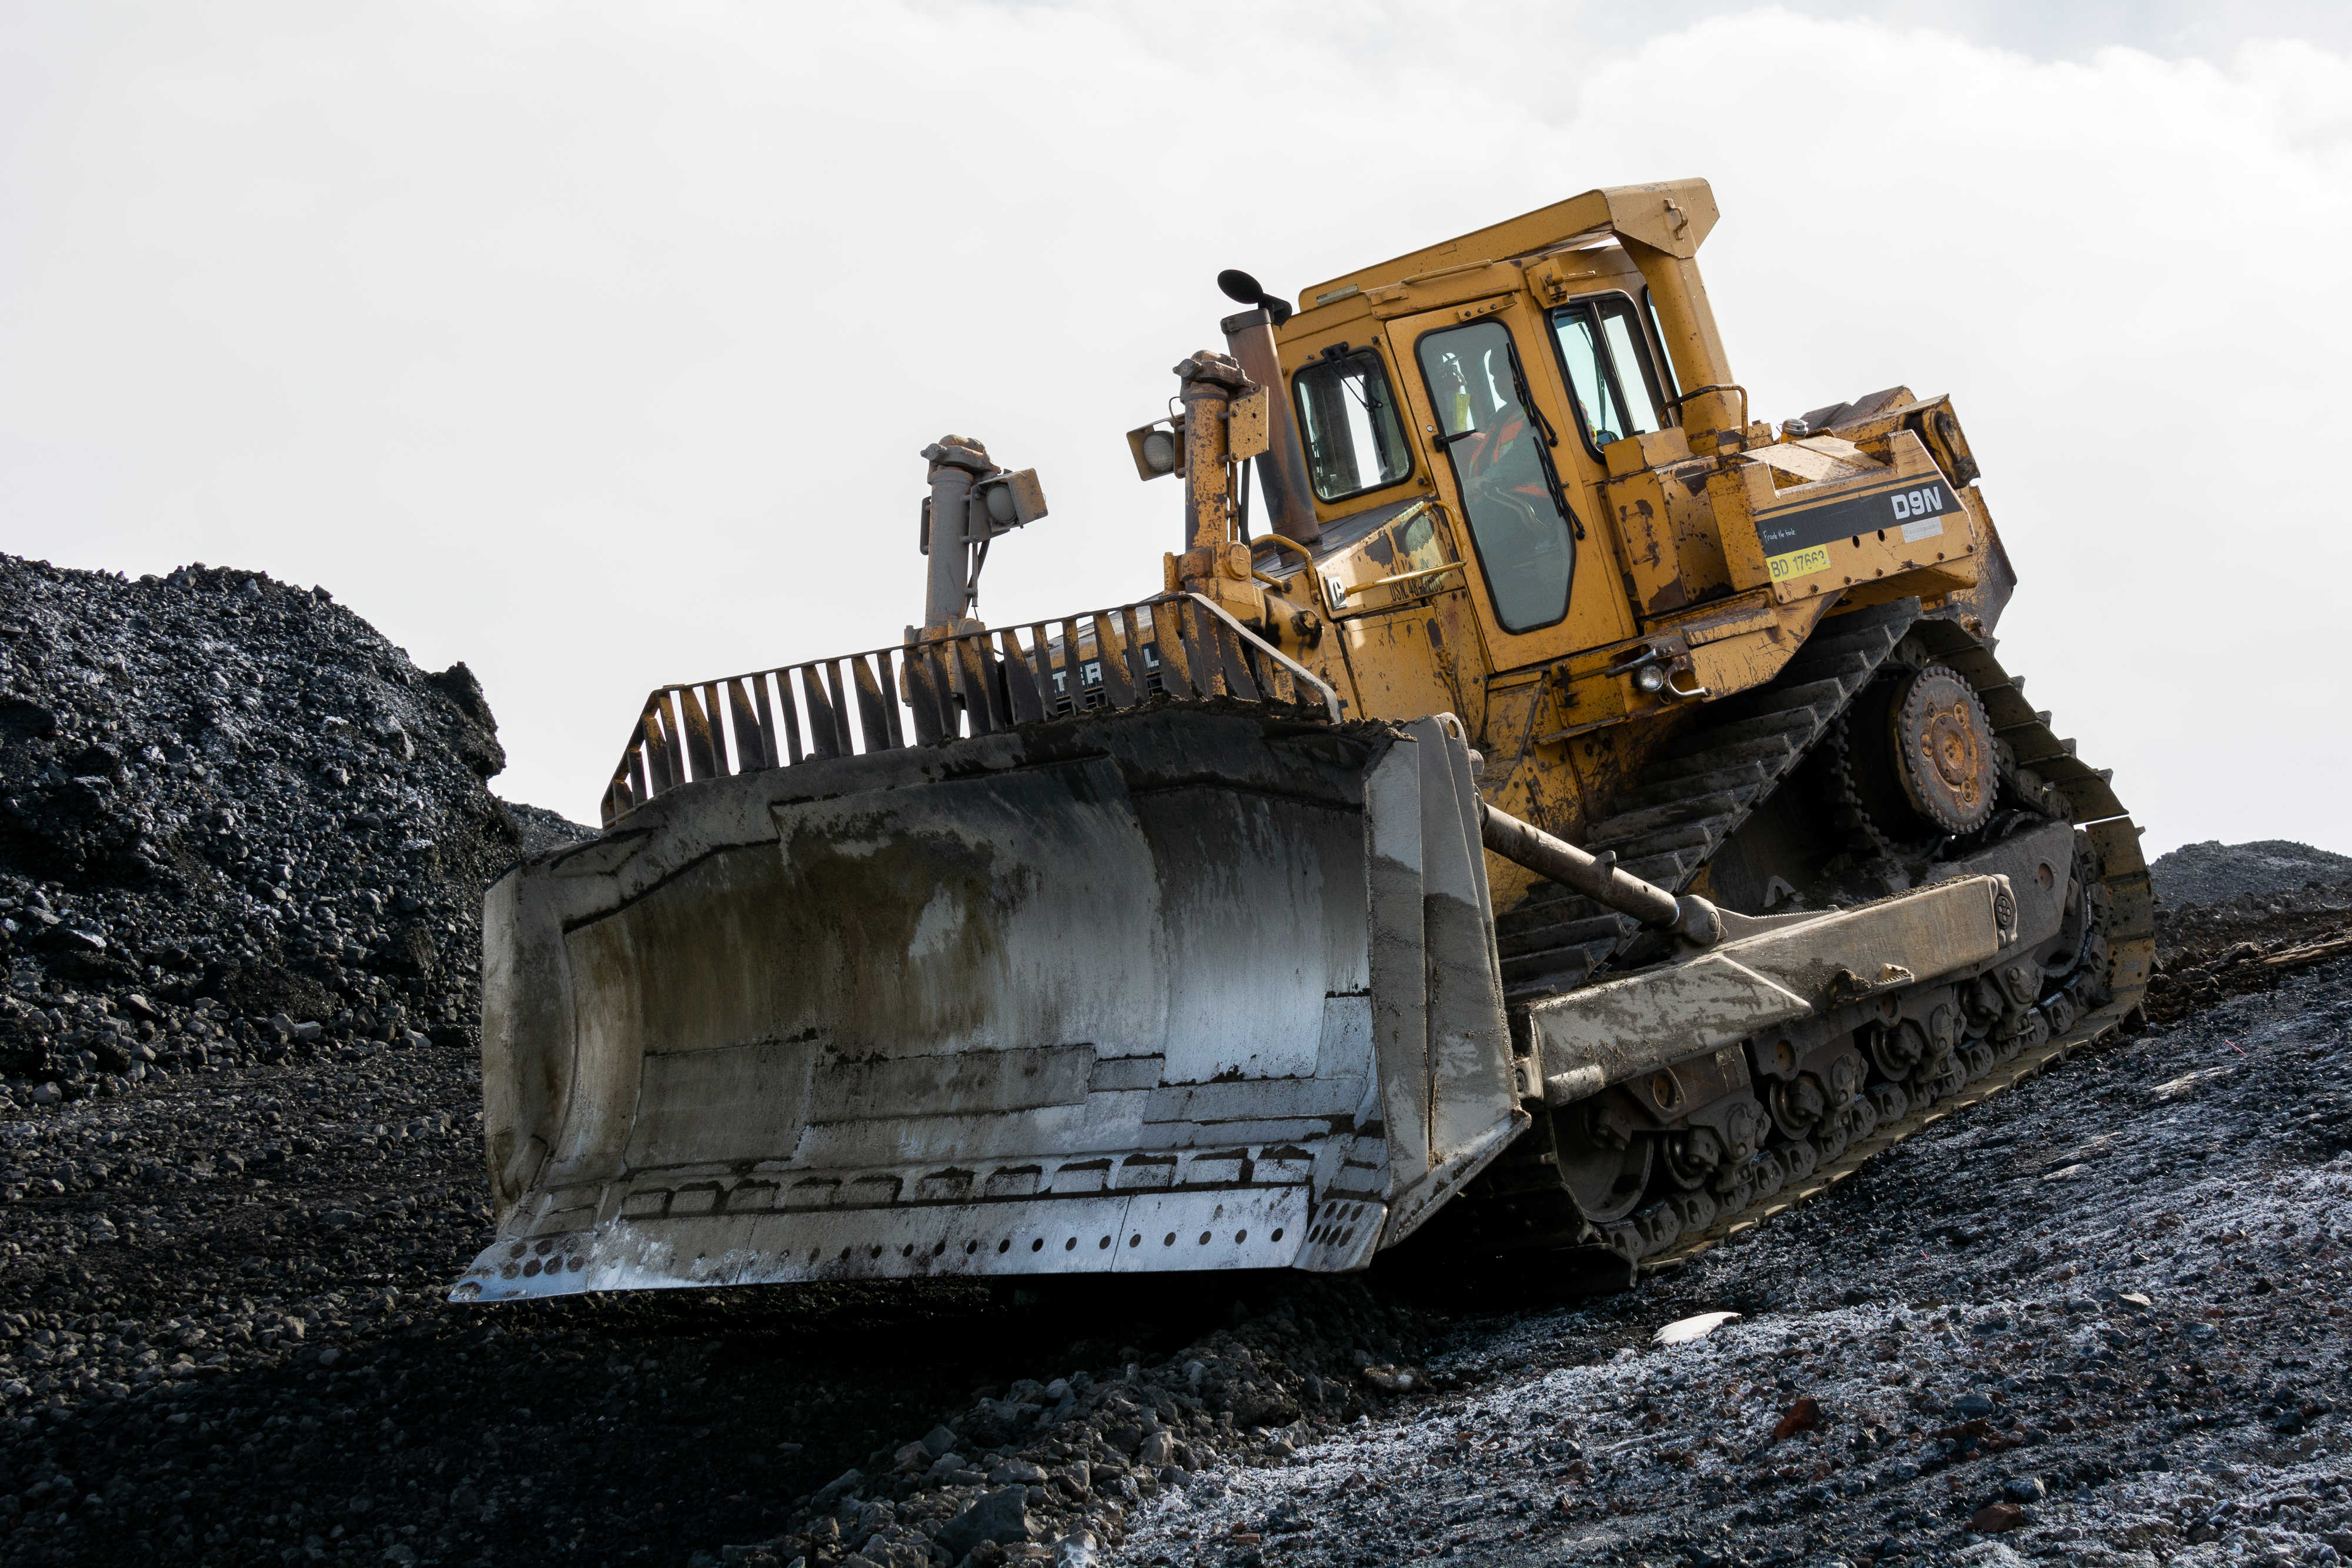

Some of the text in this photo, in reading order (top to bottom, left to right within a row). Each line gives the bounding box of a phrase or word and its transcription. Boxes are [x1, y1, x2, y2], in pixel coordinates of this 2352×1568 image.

[1891, 486, 1943, 520] D9N
[1763, 530, 1778, 544] Frank
[1770, 550, 1826, 578] BD 17663
